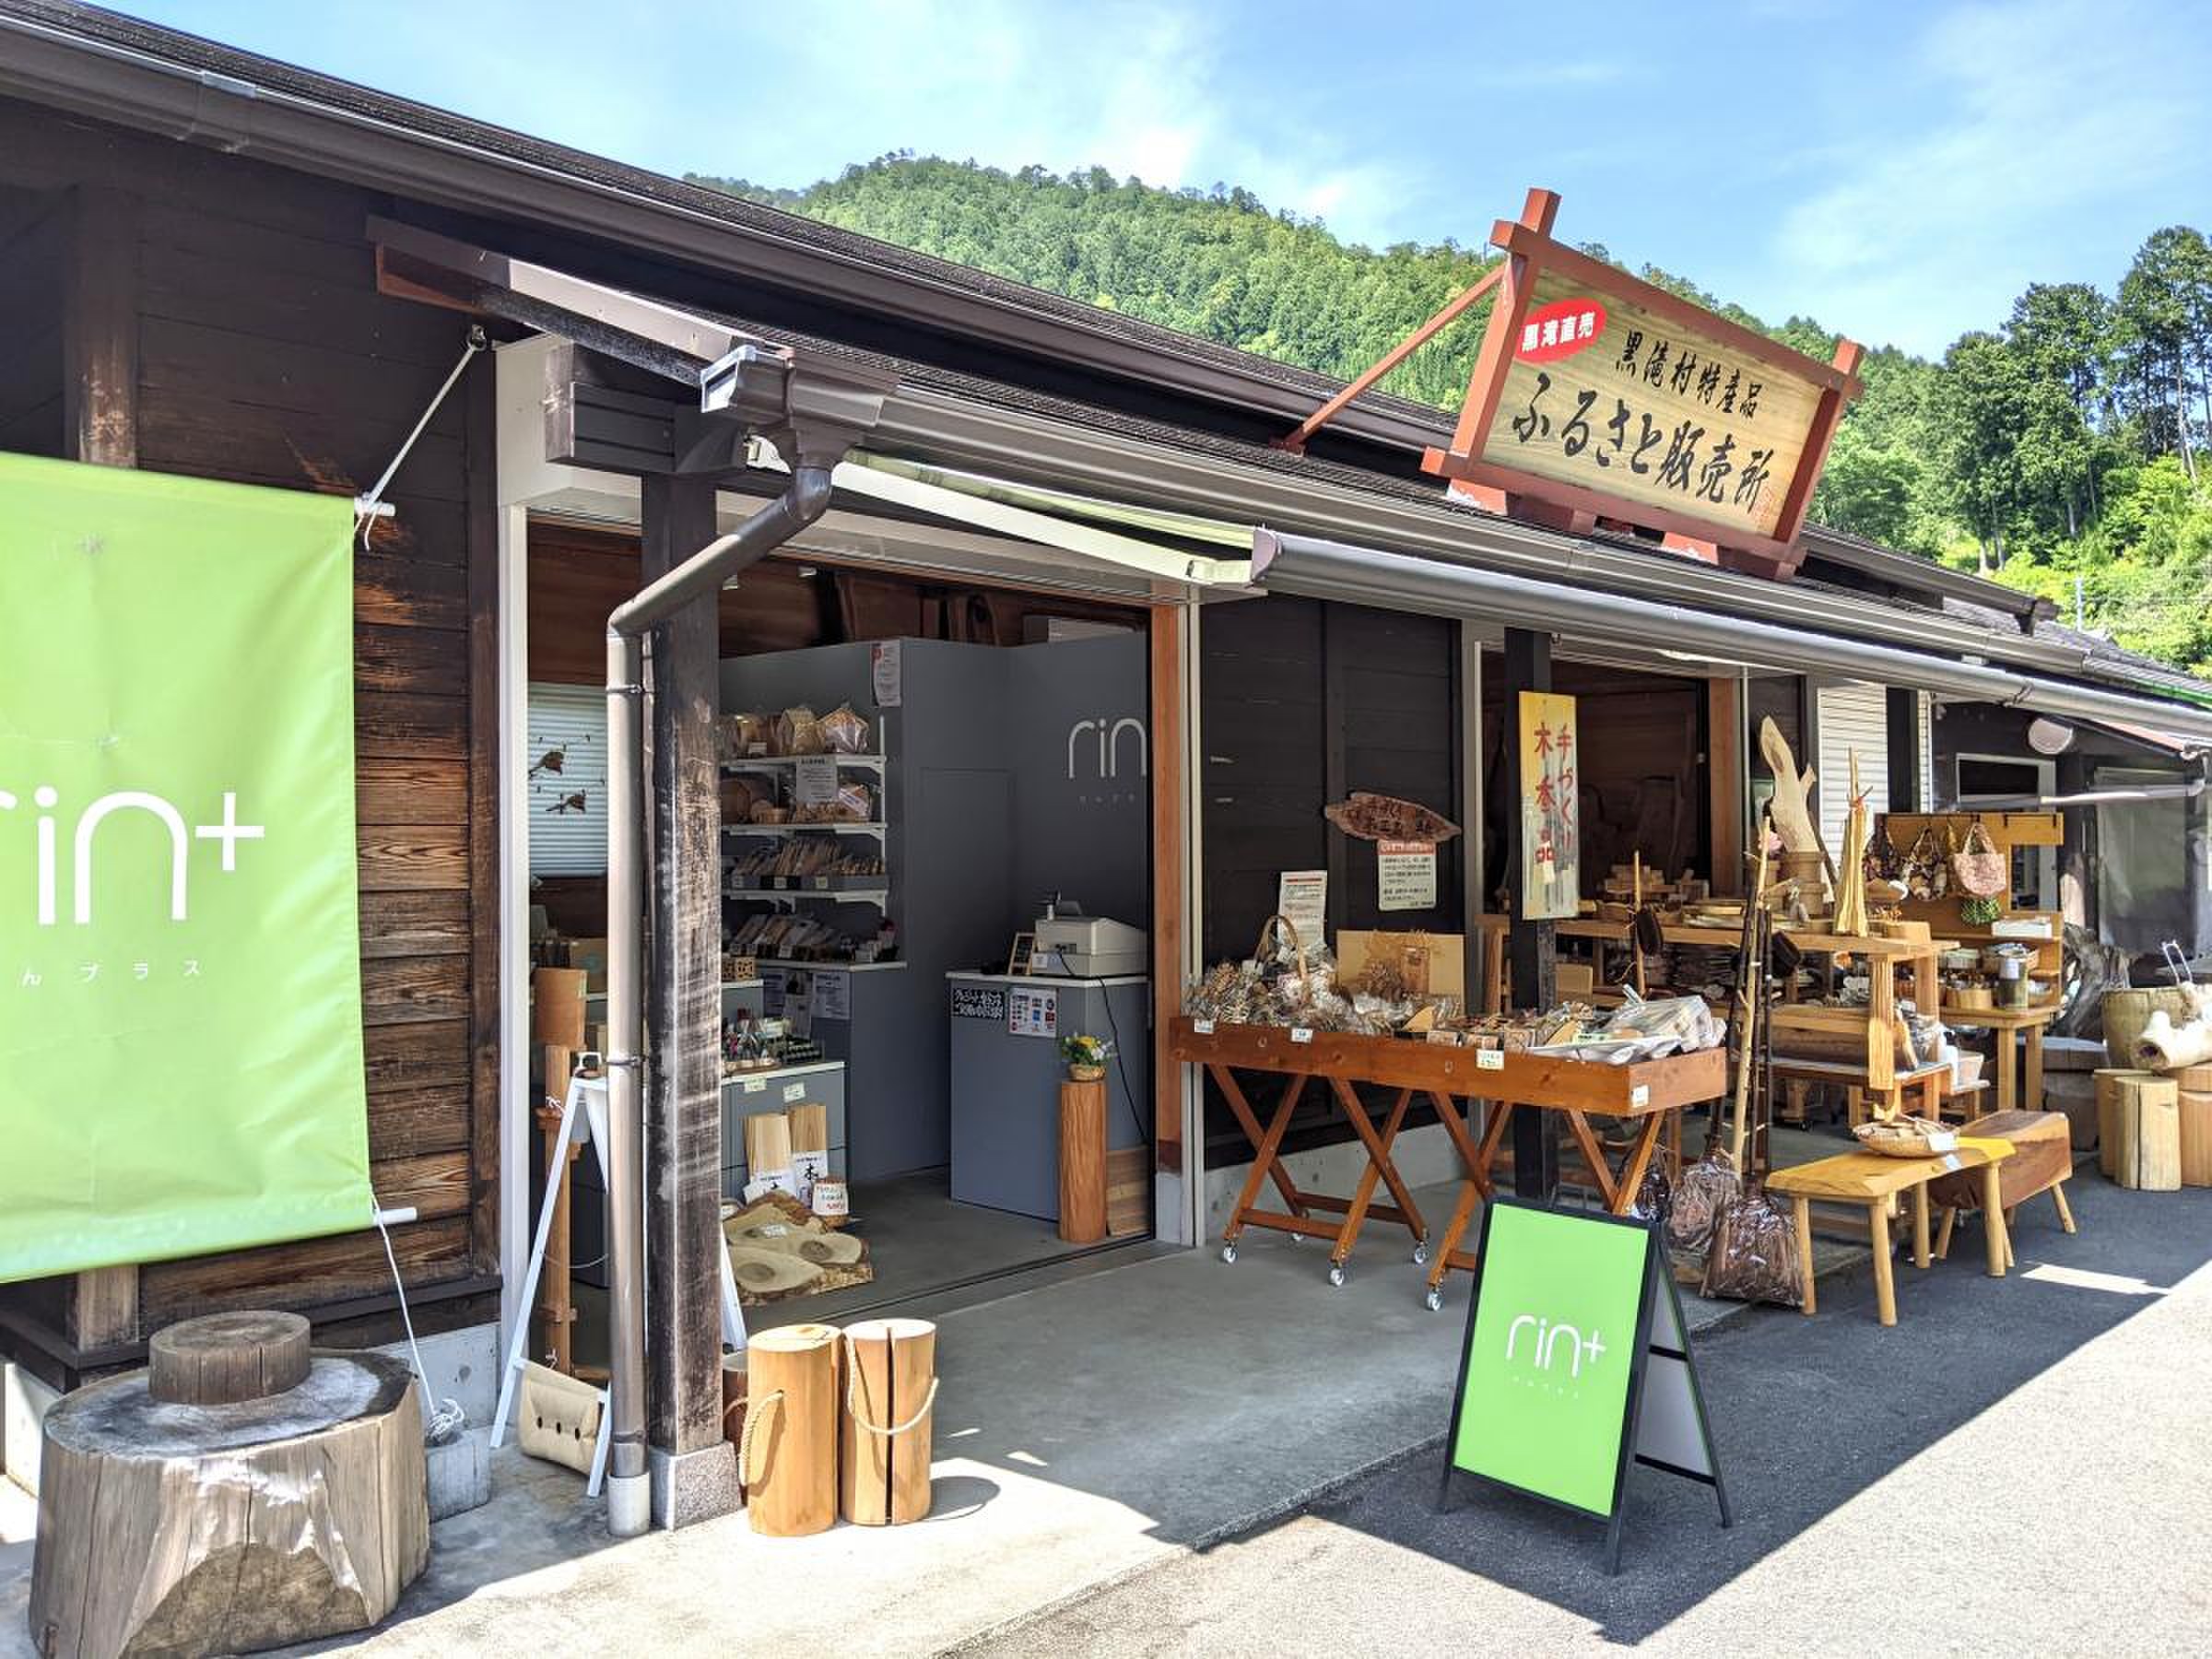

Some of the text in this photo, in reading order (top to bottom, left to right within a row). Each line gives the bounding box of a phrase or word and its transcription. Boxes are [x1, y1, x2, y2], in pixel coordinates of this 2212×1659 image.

[1512, 372, 1774, 514] ふるさと販売所
[0, 785, 265, 925] in+
[1506, 1315, 1607, 1378] rin+
